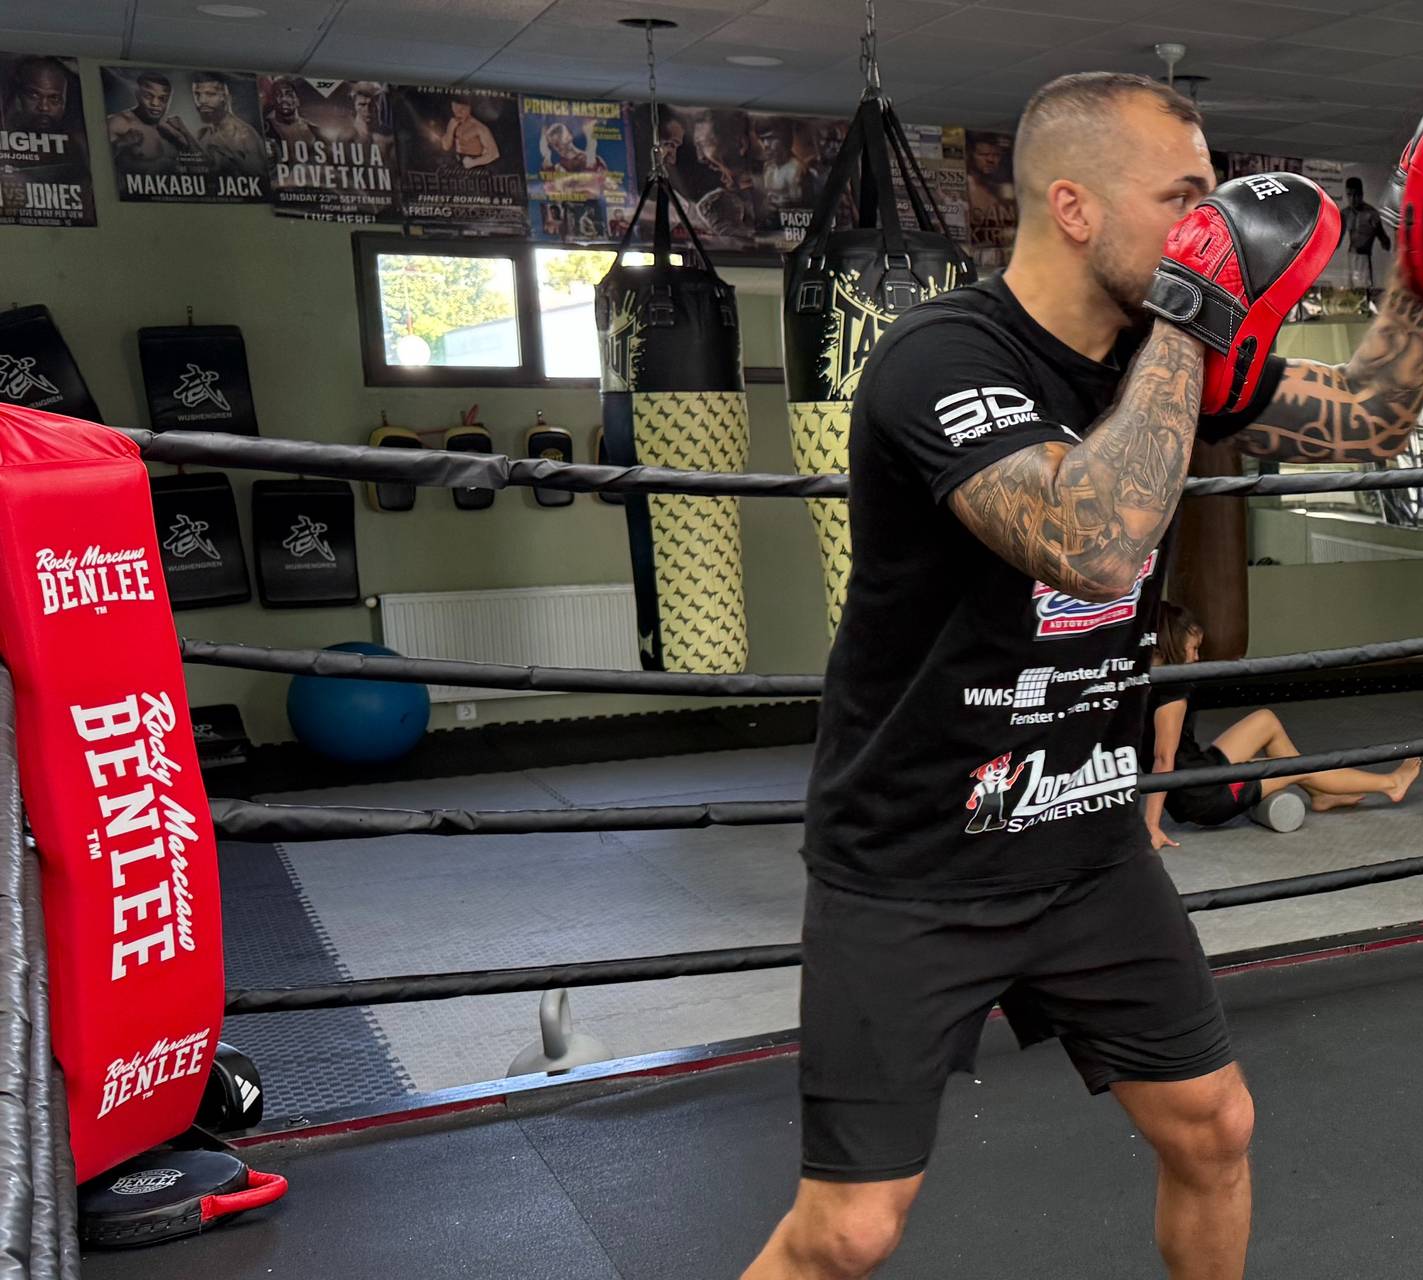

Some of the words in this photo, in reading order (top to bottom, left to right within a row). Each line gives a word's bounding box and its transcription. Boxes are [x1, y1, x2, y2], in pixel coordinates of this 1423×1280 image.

[523, 98, 569, 116] PRINCE
[0, 131, 69, 154] IGHT
[280, 140, 384, 166] JOSHUA
[126, 174, 207, 196] MAKABU
[216, 176, 263, 197] JACK
[276, 163, 393, 191] POVETKIN
[25, 182, 83, 210] JONES
[279, 192, 318, 202] SUNDAY
[950, 421, 993, 448] SPORT
[36, 549, 75, 573] Rocky
[80, 545, 145, 568] Marciano
[37, 560, 155, 616] BENLEE
[94, 606, 108, 615] TM
[963, 687, 1015, 706] WMS
[1051, 667, 1101, 684] Fenster
[1010, 711, 1055, 726] Fenster
[140, 690, 183, 788] Rocky
[69, 693, 175, 982] BENLEE
[85, 828, 102, 860] TM
[158, 793, 199, 952] Marciano
[105, 1051, 143, 1084] Rocky
[144, 1026, 211, 1065] Marciano
[96, 1039, 208, 1120] BENLEE
[142, 1089, 154, 1101] TM
[111, 1174, 179, 1190] BENLEE
